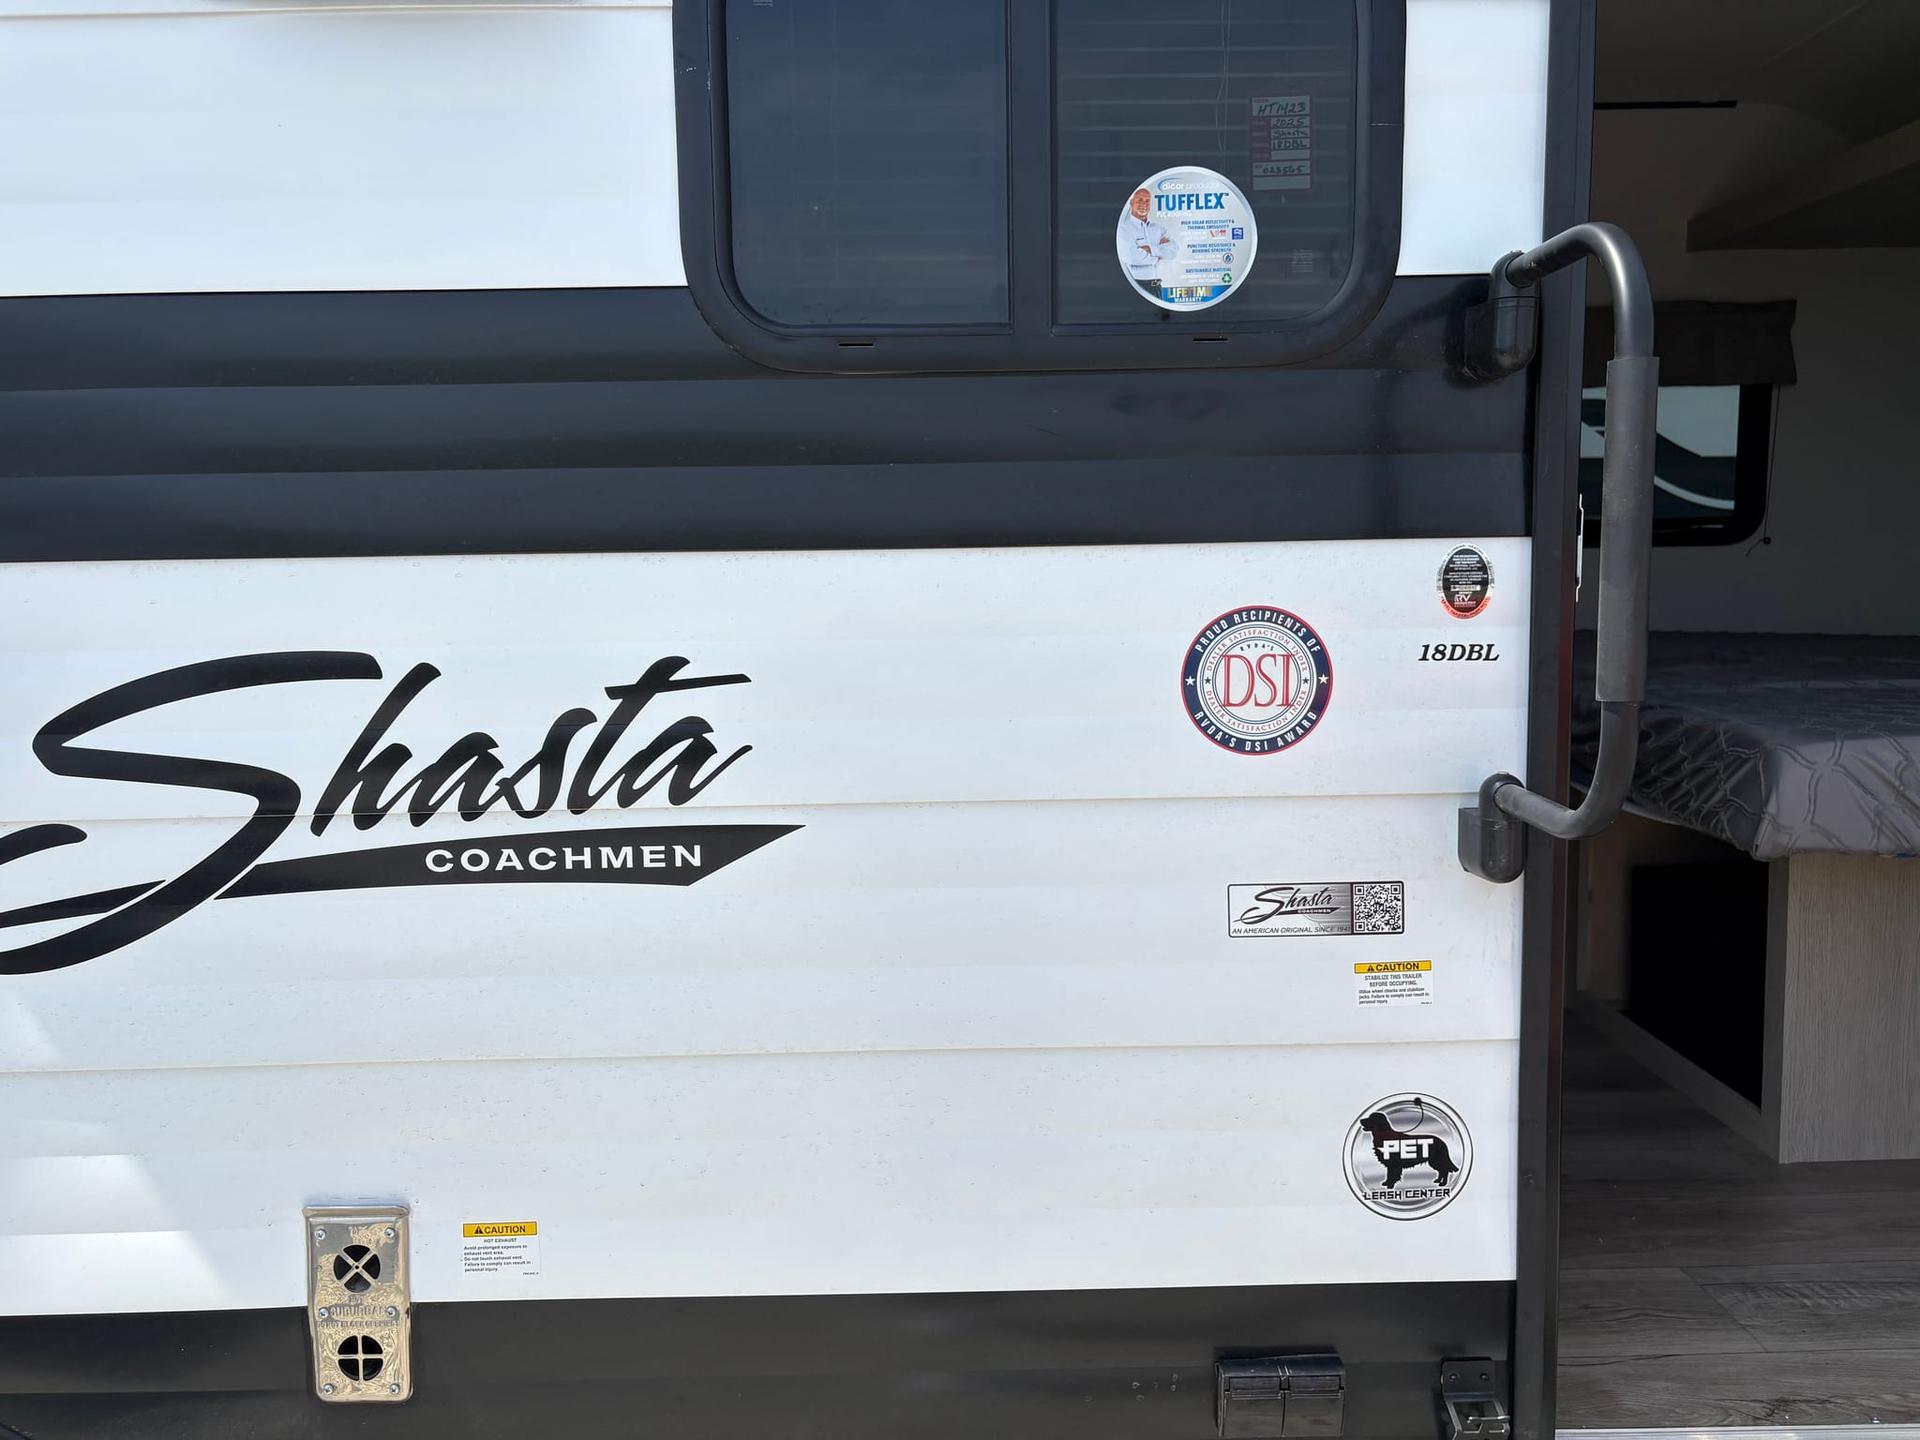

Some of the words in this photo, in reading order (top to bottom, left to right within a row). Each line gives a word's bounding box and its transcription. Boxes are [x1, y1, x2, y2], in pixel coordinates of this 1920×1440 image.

[1273, 118, 1305, 129] 2025
[1194, 619, 1229, 653] PROUD
[1233, 610, 1307, 637] RECIPIENTS
[1306, 637, 1321, 653] OF
[1228, 629, 1291, 645] SATISFACTION
[1291, 645, 1308, 672] INDEX
[1418, 643, 1501, 662] 18DBL
[1220, 653, 1294, 708] DSI
[1227, 715, 1289, 732] SATISFACTION
[1290, 690, 1308, 717] INDEX
[1194, 711, 1236, 748] RVDA'S
[1245, 740, 1268, 751] DSI
[1276, 711, 1318, 748] AWARD
[0, 650, 753, 976] Shasta
[424, 843, 703, 874] COACHMEN
[1233, 886, 1336, 925] Shasta
[1376, 962, 1420, 972] CAUTION
[1381, 1138, 1434, 1160] PET
[1362, 1190, 1402, 1201] LEASH
[1404, 1188, 1451, 1199] CENTER
[484, 1225, 526, 1235] CAUTION
